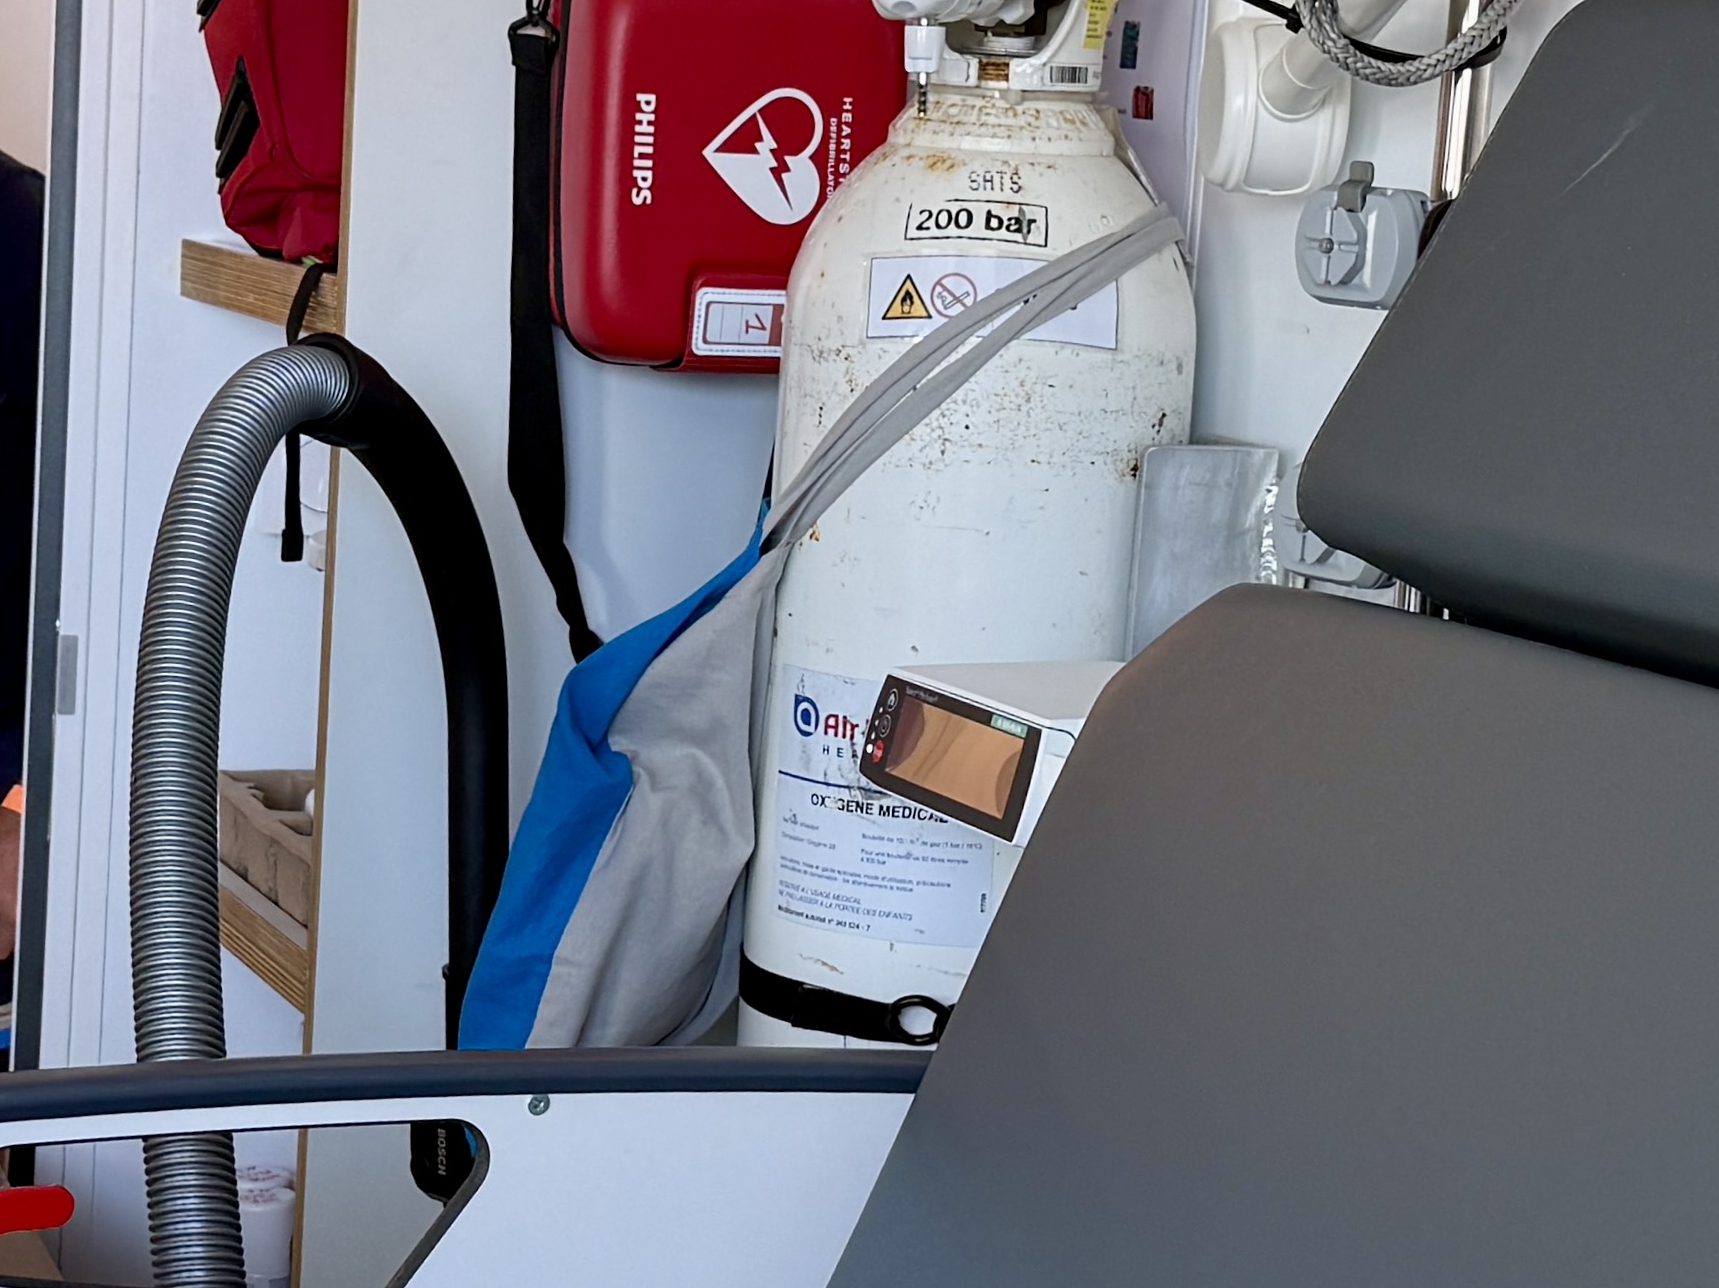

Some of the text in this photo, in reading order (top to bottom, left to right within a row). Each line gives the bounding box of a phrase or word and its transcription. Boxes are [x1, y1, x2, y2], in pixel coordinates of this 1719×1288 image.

[631, 93, 657, 206] PHILIPS
[968, 170, 1023, 194] SATS
[915, 207, 1037, 236] 200 bar
[824, 713, 859, 741] Air
[810, 793, 874, 816] OXGENE
[437, 1128, 447, 1176] BOSCH
